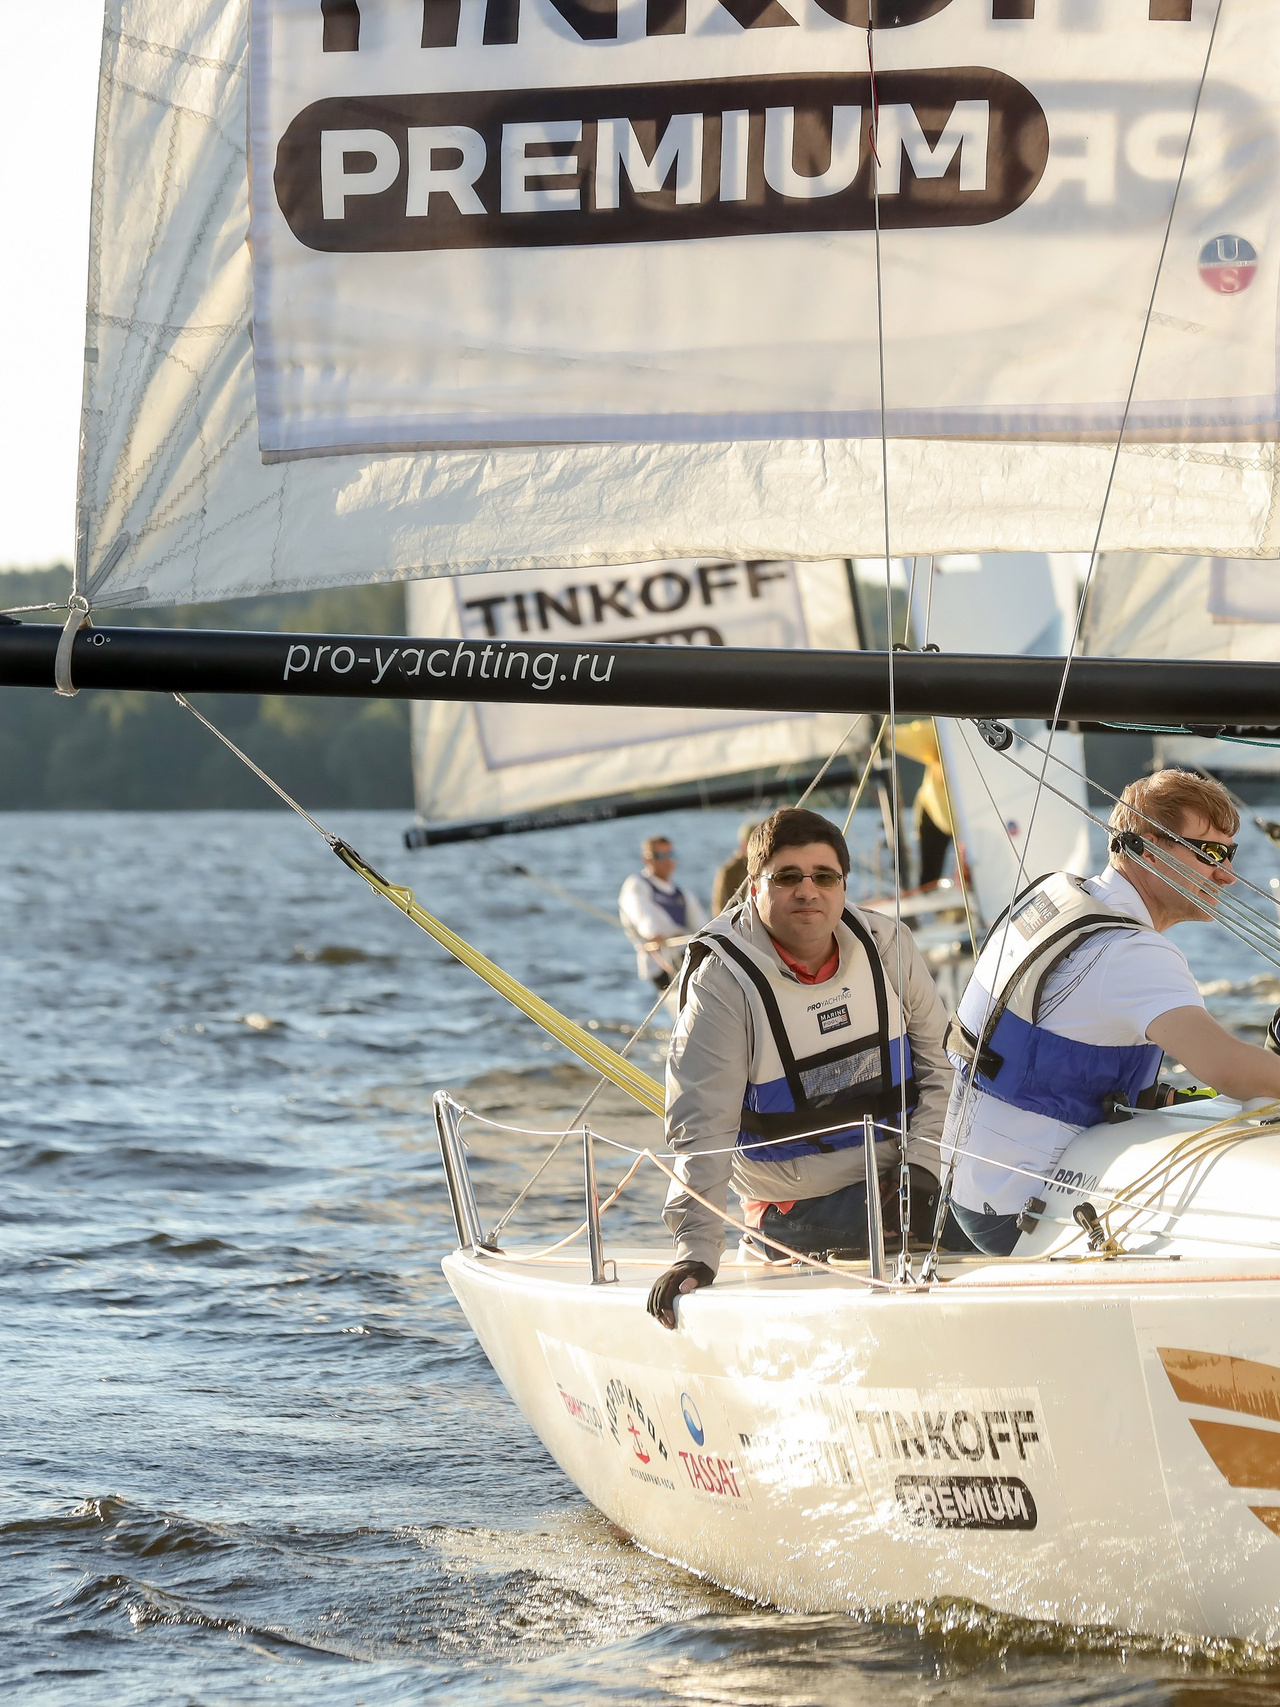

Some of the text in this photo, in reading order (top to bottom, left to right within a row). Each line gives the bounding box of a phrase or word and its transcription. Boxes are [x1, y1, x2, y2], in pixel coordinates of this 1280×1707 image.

[319, 99, 990, 220] PREMIUM
[464, 560, 787, 637] TINKOFF
[283, 641, 616, 691] pro-yachting.ru
[1033, 895, 1053, 920] MARINE
[807, 991, 852, 1012] PROYACHTING
[820, 1008, 847, 1021] MARINE
[856, 1411, 1039, 1462] TINKOFF
[679, 1451, 741, 1497] TASSAY
[902, 1486, 1030, 1521] PREMIUM
